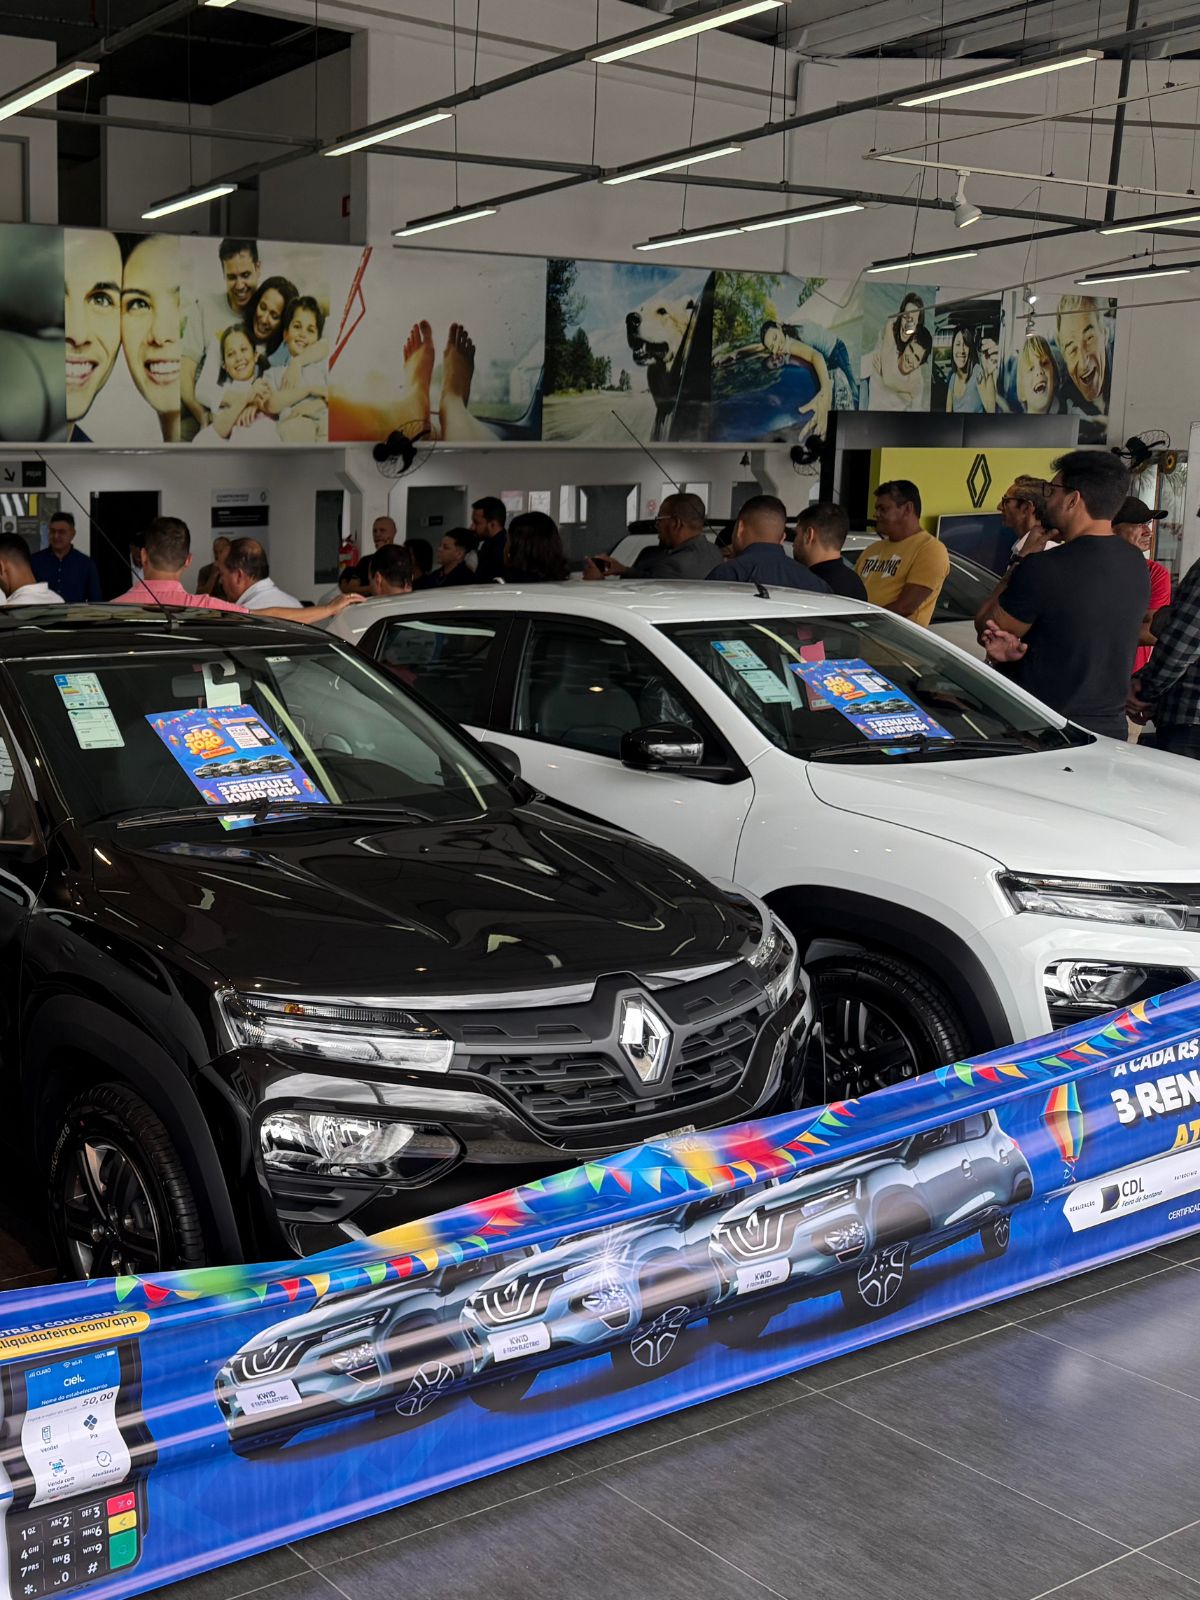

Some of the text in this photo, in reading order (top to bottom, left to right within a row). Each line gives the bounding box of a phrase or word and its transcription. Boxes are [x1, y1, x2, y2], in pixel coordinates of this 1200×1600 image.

[230, 778, 295, 793] RENAULT
[225, 790, 267, 803] KWID
[1113, 1038, 1199, 1078] A CADA R$
[1110, 1088, 1137, 1124] 3
[1121, 1177, 1145, 1198] CDL
[754, 1270, 772, 1280] KWID
[31, 1324, 40, 1332] E
[509, 1334, 529, 1345] KWID
[81, 1391, 114, 1407] 50,00
[256, 1390, 277, 1401] KWID
[93, 1506, 100, 1518] 3
[63, 1516, 70, 1528] 2
[21, 1530, 27, 1541] 1
[95, 1526, 102, 1537] 6
[63, 1535, 70, 1547] 5
[95, 1543, 102, 1554] 9
[21, 1549, 29, 1560] 4
[63, 1553, 71, 1564] 8
[21, 1567, 27, 1578] 7
[61, 1571, 70, 1582] 0
